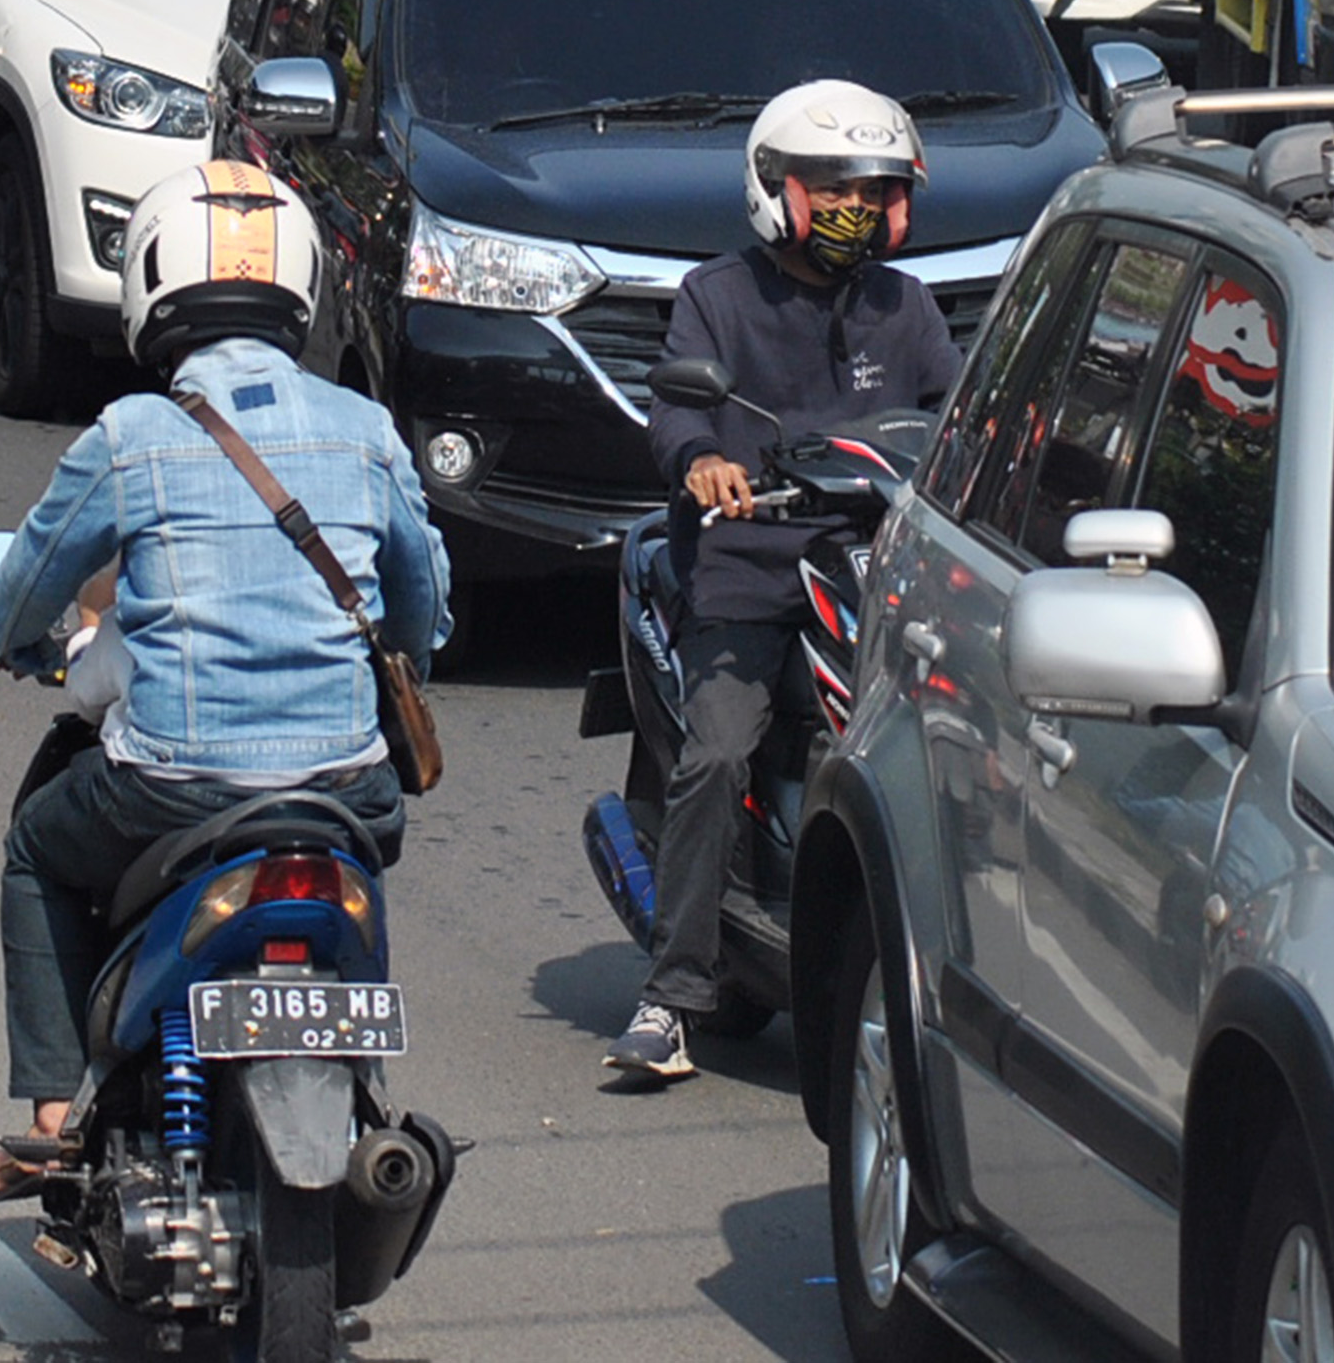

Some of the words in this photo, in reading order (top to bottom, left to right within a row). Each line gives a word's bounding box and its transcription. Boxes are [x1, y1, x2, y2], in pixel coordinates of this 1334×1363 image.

[201, 988, 222, 1021] F
[250, 987, 328, 1019] 3165
[348, 989, 391, 1019] MB
